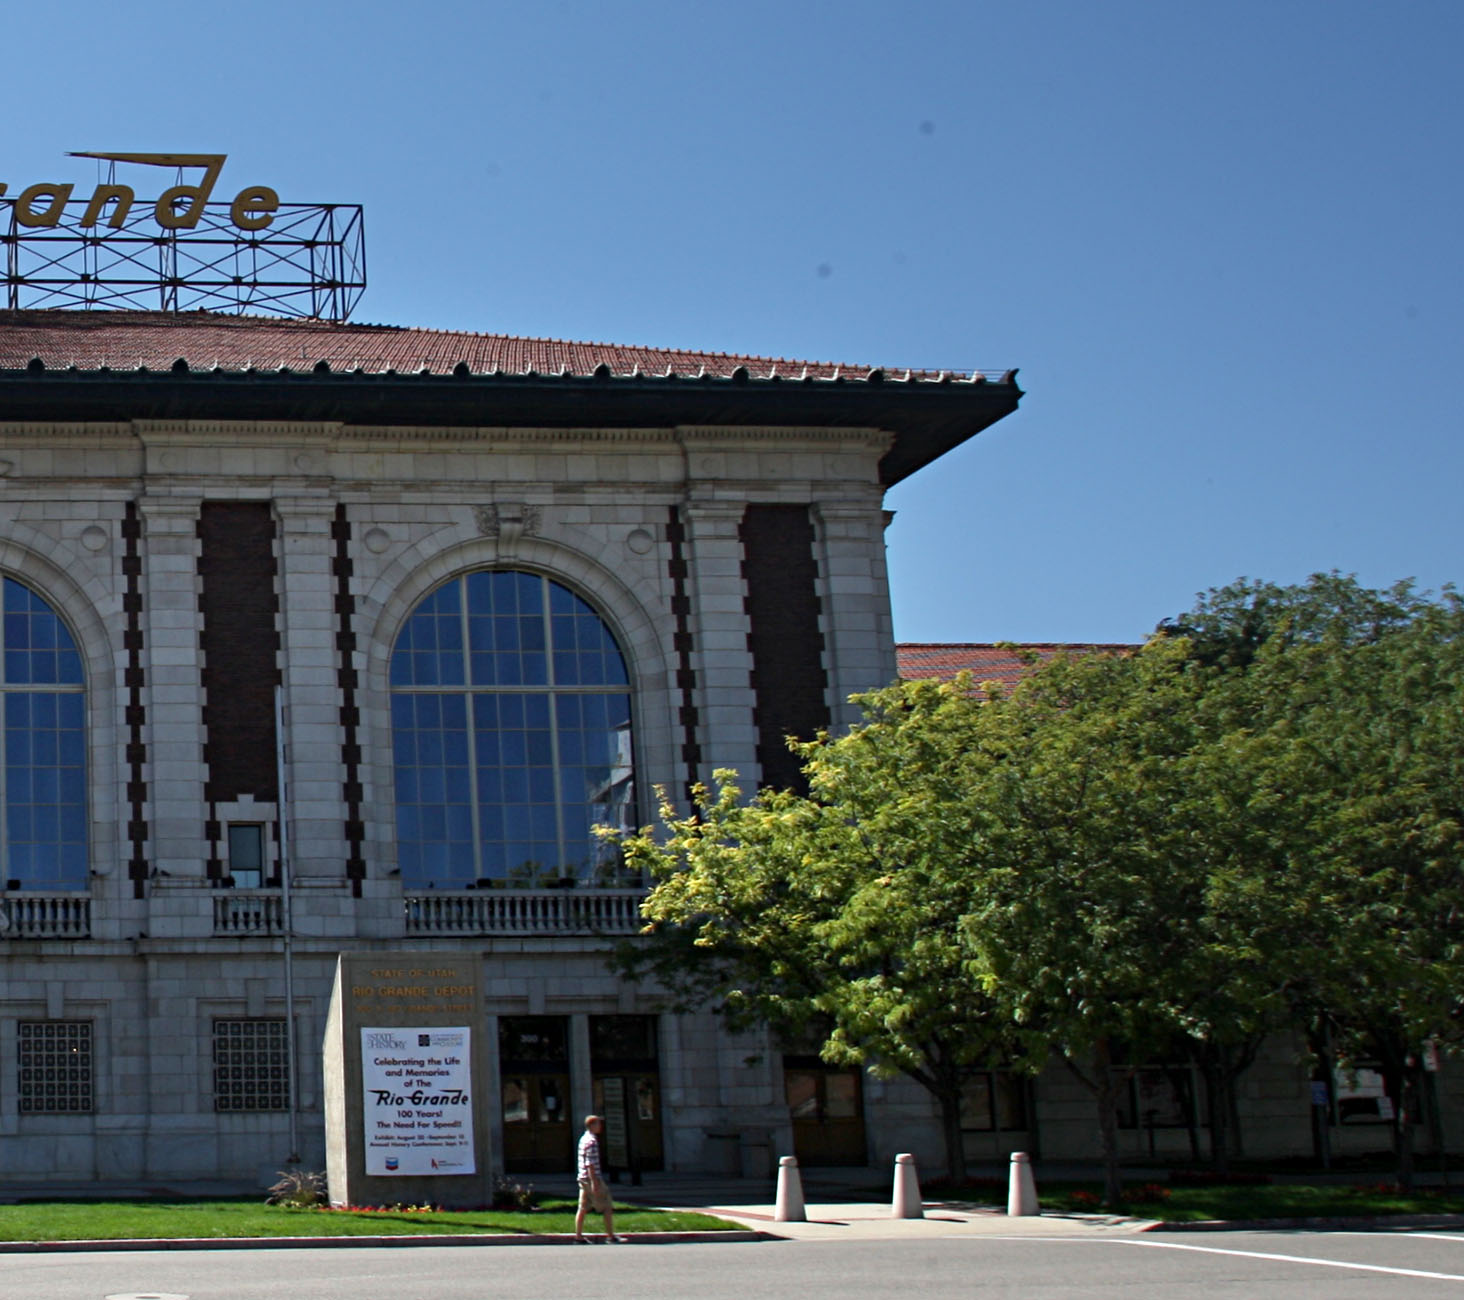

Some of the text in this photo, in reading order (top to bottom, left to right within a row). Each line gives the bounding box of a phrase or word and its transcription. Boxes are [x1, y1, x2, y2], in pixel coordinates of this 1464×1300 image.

[370, 968, 456, 978] STATE OF UTAH
[352, 986, 475, 997] RIO GRANDE DEPOT
[374, 1057, 461, 1067] Celebrating the Life
[385, 1068, 450, 1077] and Memories
[403, 1079, 432, 1087] of The
[367, 1089, 469, 1106] Rio Grande
[397, 1110, 444, 1118] 100 Years!
